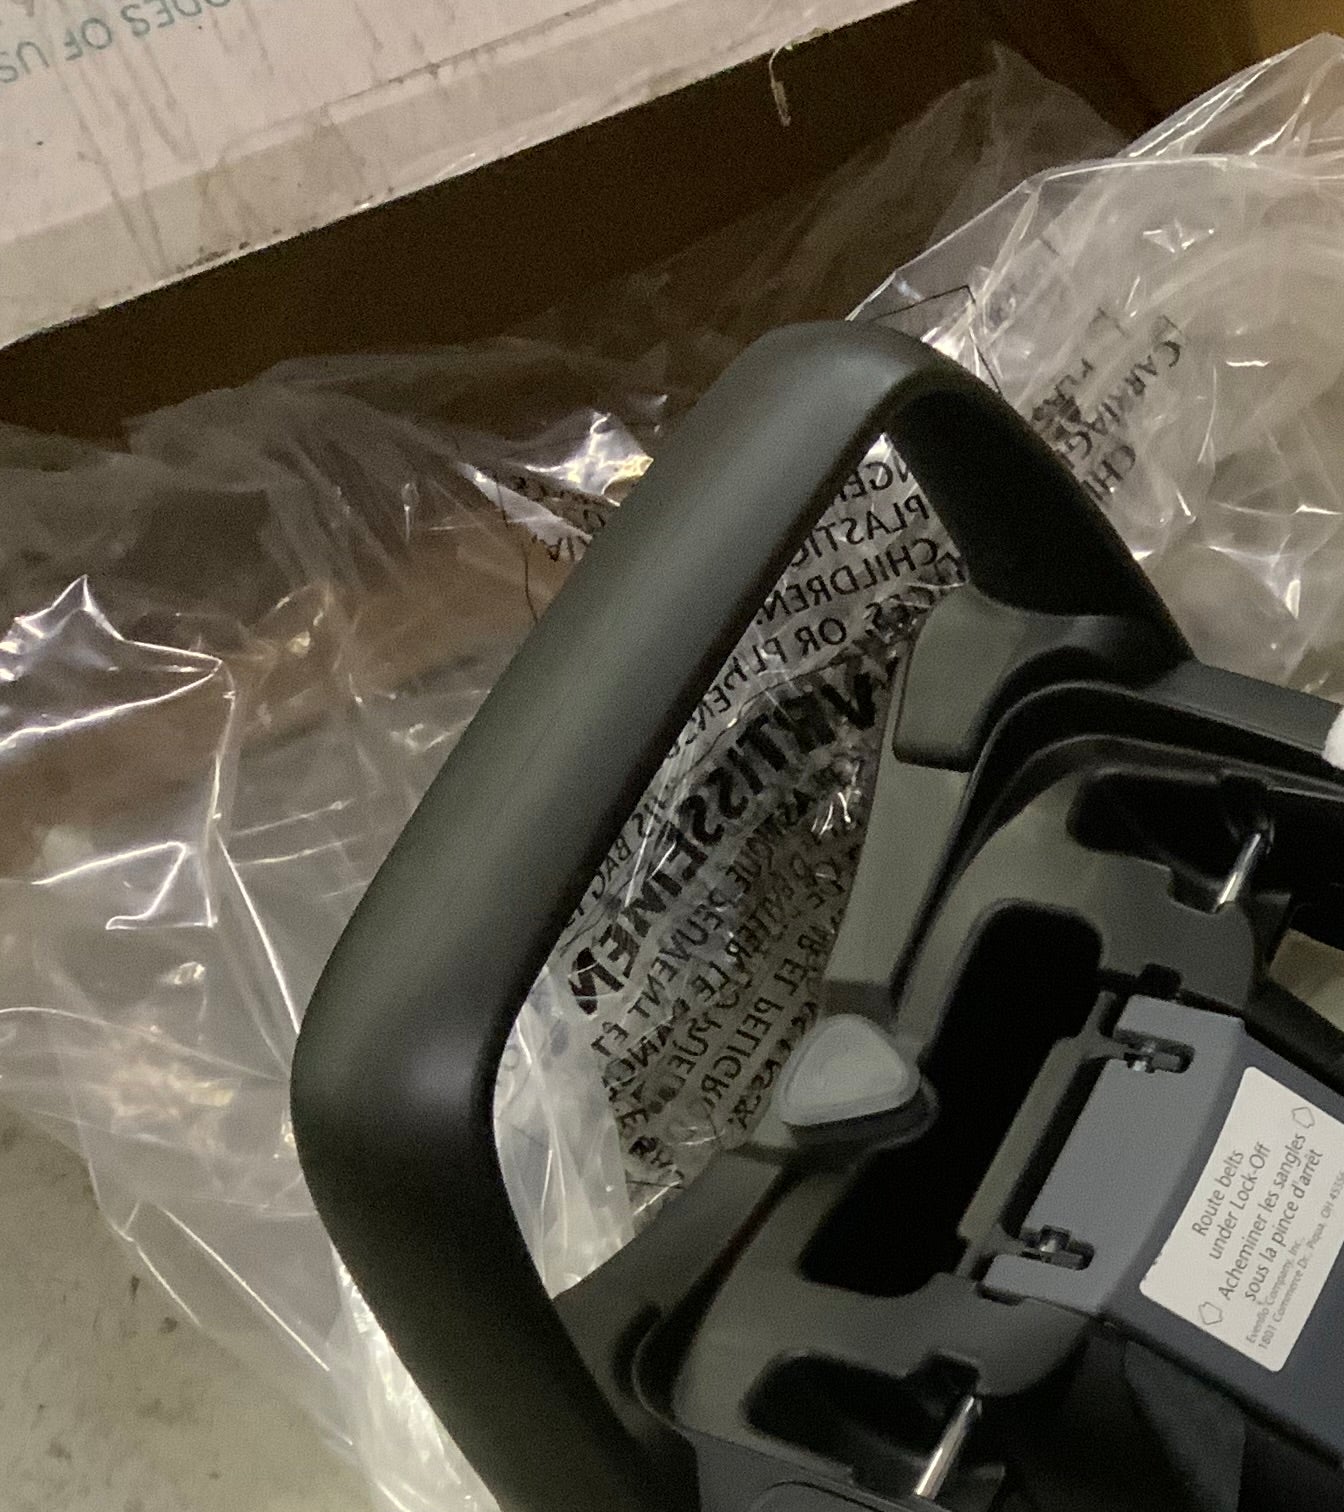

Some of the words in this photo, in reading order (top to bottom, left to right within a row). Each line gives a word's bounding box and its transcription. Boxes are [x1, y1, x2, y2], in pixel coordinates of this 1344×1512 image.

[64, 17, 113, 62] OF
[1190, 1189, 1225, 1237] Route
[1213, 1149, 1244, 1188] belts
[1208, 1210, 1238, 1260] under
[1228, 1141, 1270, 1210] Lock-Off
[1217, 1213, 1267, 1301] Acheminer
[1256, 1189, 1280, 1213] les
[1272, 1132, 1306, 1189] sangles
[1243, 1263, 1270, 1302] sous
[1257, 1246, 1278, 1263] la
[1270, 1200, 1299, 1248] pince
[1290, 1148, 1323, 1199] d'arrêt
